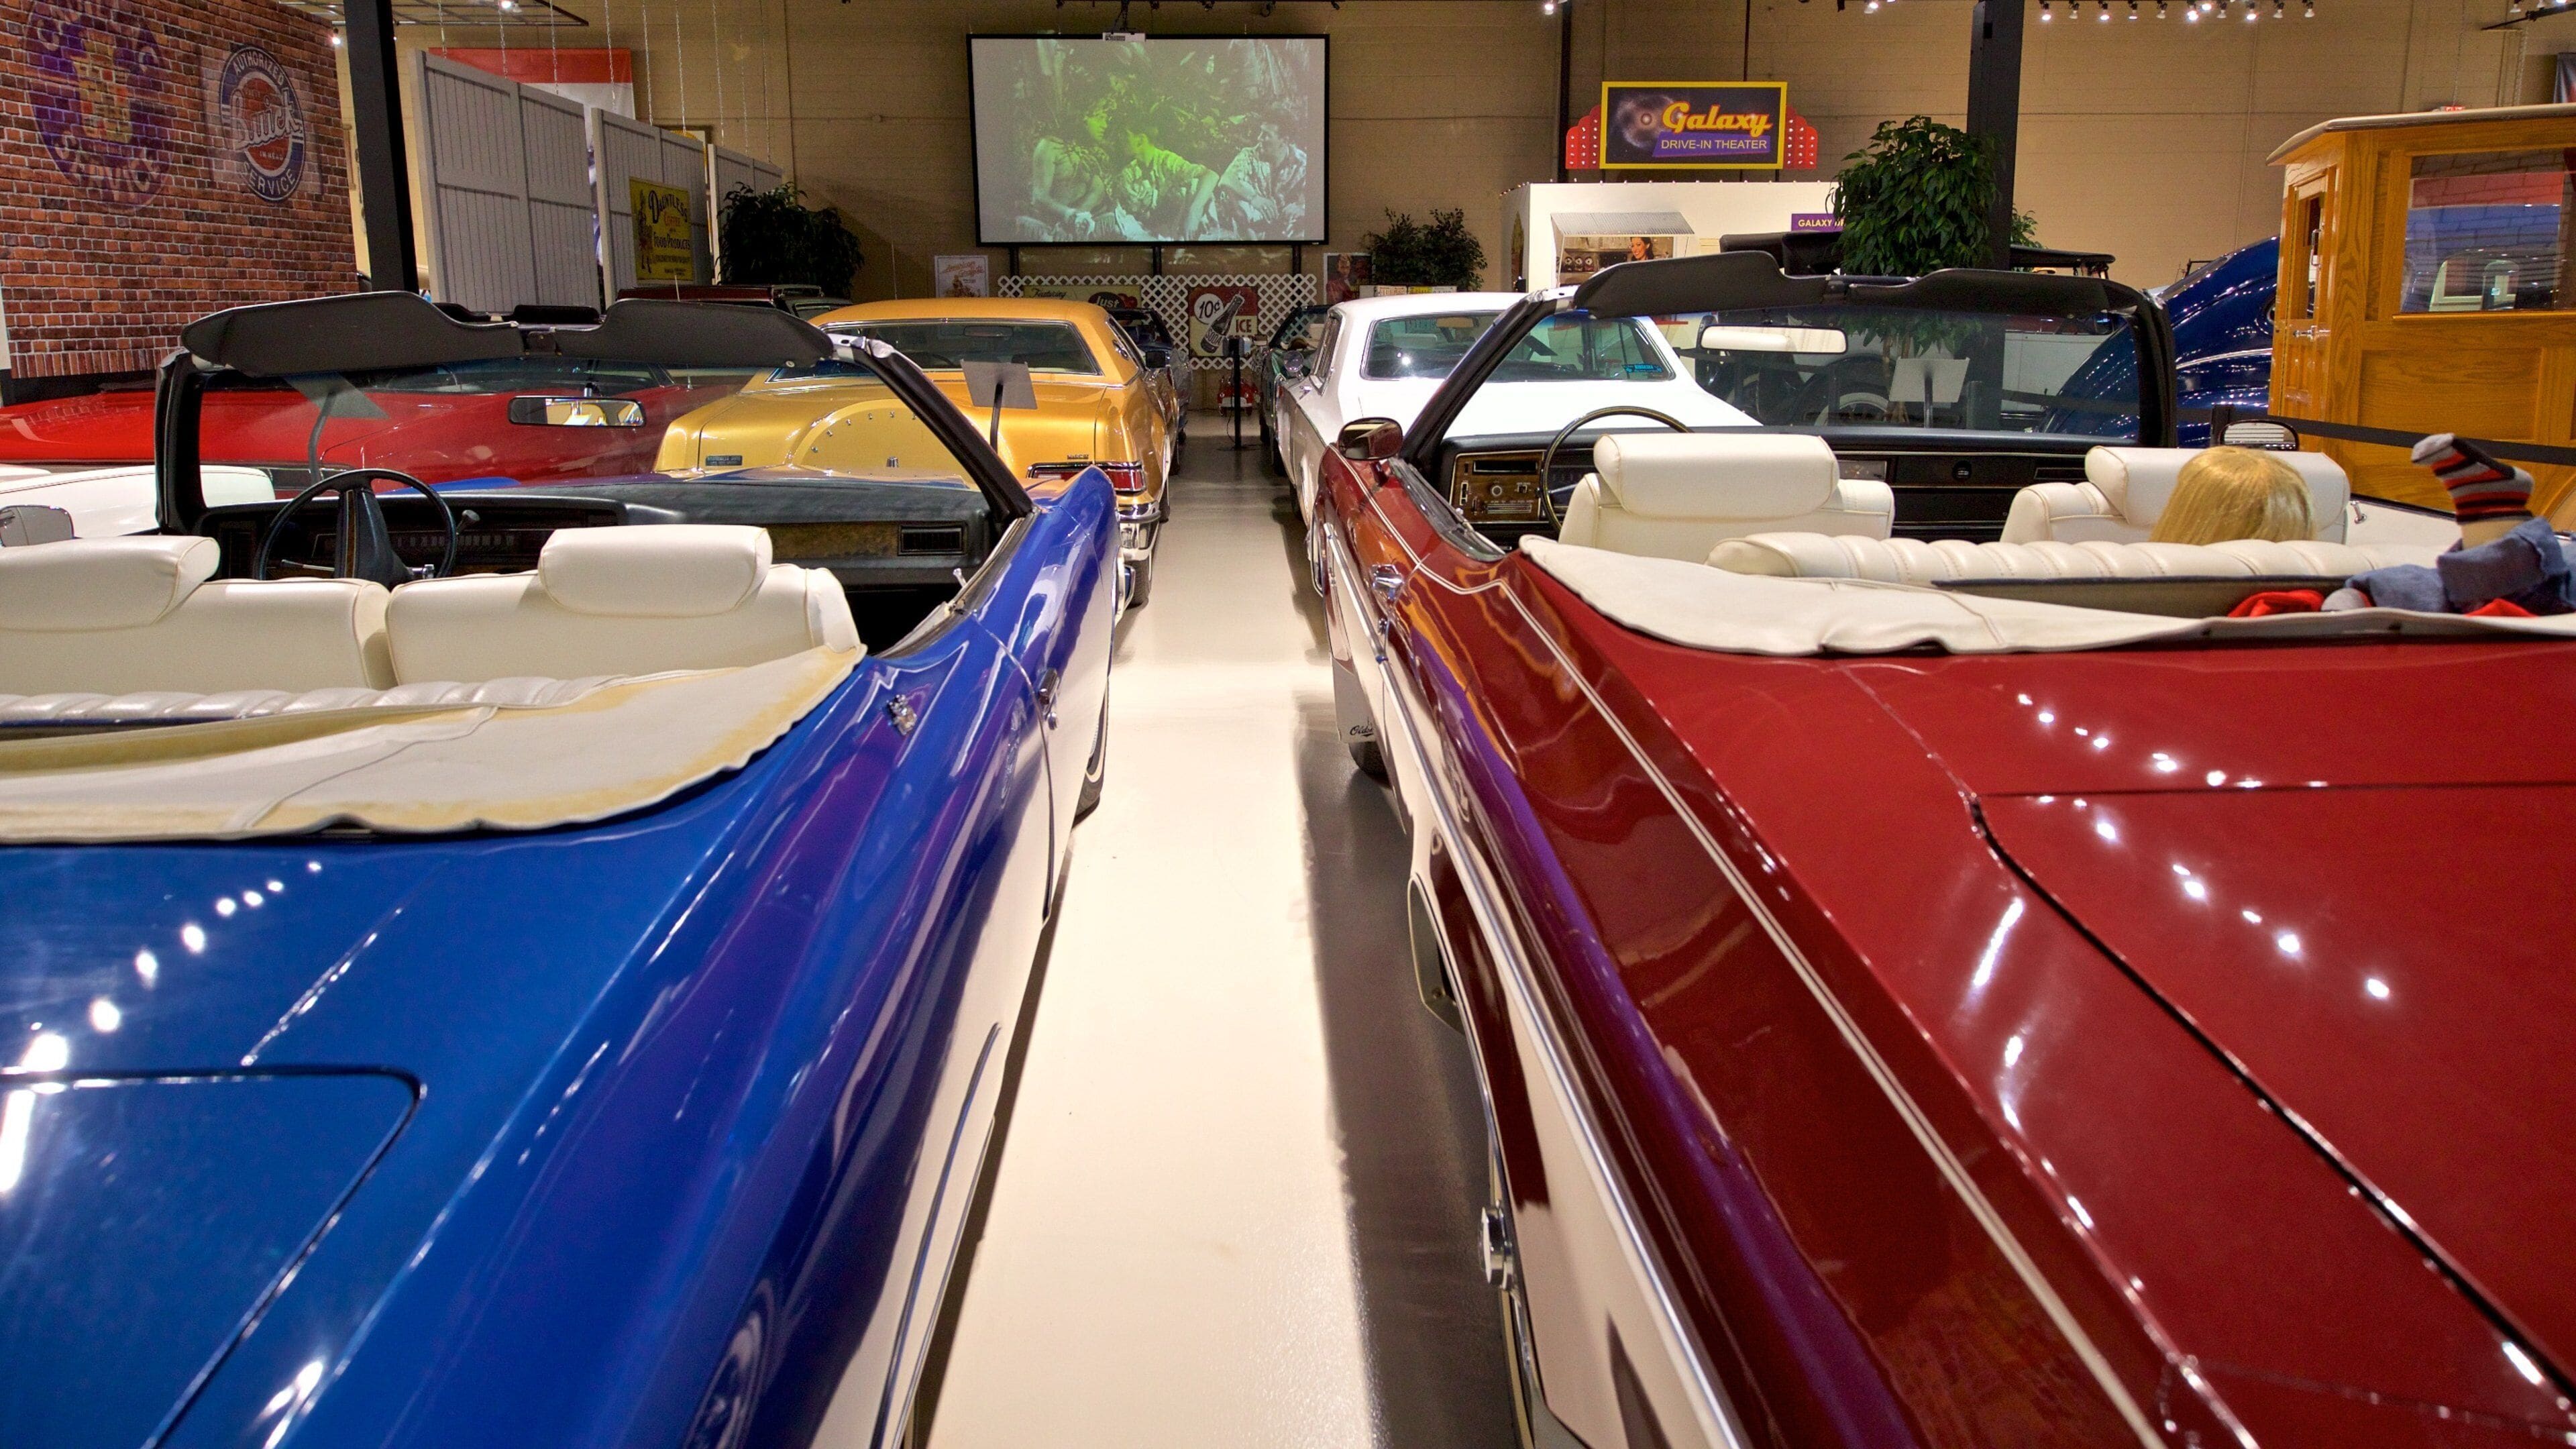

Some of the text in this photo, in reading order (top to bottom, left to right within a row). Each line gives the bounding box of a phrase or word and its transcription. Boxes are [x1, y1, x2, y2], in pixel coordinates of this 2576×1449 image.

[233, 51, 285, 86] AUTHORIZED
[230, 87, 301, 150] Buick
[1661, 101, 1773, 138] Galaxy
[1661, 140, 1767, 149] DRIVE-IN THEATER
[242, 162, 296, 195] SERVICE
[1205, 329, 1222, 345] SODA
[1236, 319, 1252, 333] ICE
